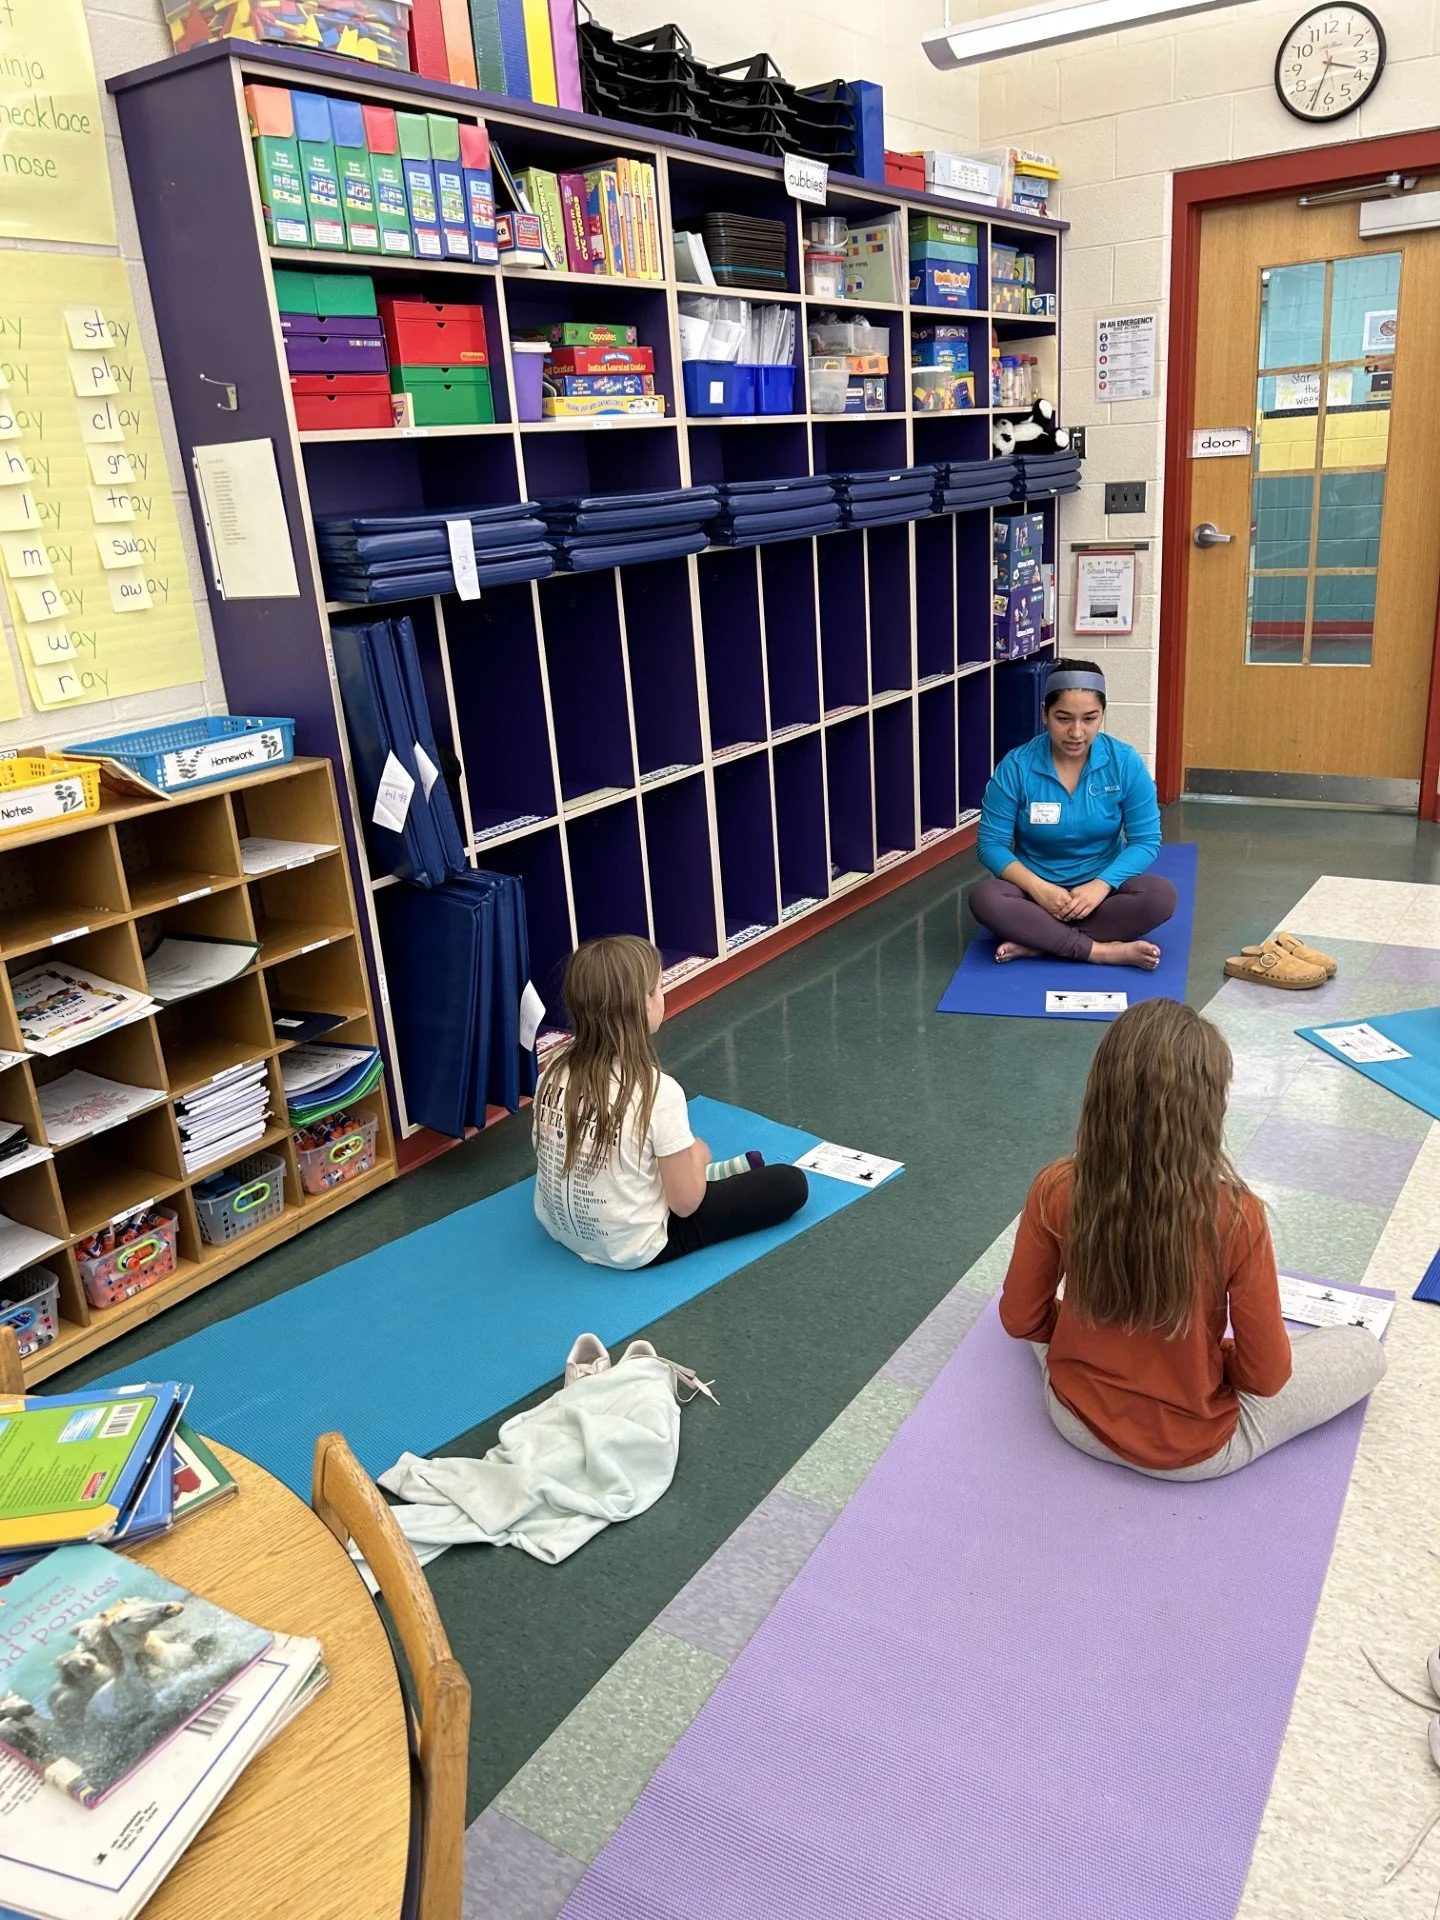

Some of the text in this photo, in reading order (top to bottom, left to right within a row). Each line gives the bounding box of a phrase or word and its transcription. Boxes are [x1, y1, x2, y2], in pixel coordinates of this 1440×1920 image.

[1324, 20, 1339, 34] 12
[1347, 22, 1351, 34] 1
[1310, 29, 1320, 42] 11
[1353, 34, 1364, 47] 2
[1297, 44, 1313, 58] 10
[1358, 51, 1368, 63] 3
[1292, 64, 1302, 76] 9
[1353, 69, 1363, 81] 4
[1296, 80, 1306, 91] 8
[1340, 84, 1350, 96] 5
[1308, 90, 1317, 102] 7
[1324, 92, 1334, 104] 6
[0, 94, 91, 134] necklace
[3, 153, 58, 179] nose
[789, 172, 823, 193] cubbies
[573, 196, 589, 261] CVC WORDS
[1117, 316, 1153, 327] EMERGENCY
[83, 310, 130, 347] stay
[589, 332, 617, 344] Opposites
[91, 356, 134, 392] play
[587, 363, 646, 372] Instant Learning Center
[1291, 373, 1311, 384] Star
[1304, 385, 1319, 394] the
[92, 402, 141, 435] clay
[1201, 436, 1241, 449] door
[5, 451, 148, 487] hay gray
[22, 488, 152, 530] lay tray
[22, 537, 158, 575] may sway
[1105, 568, 1124, 577] Pledge
[41, 577, 169, 615] pay away
[47, 630, 97, 659] way
[58, 670, 110, 695] ray
[211, 748, 255, 767] Homework
[1, 805, 34, 819] Notes
[573, 1188, 594, 1197] JASMINE
[573, 1194, 607, 1205] POCAHONTAS
[31, 1577, 118, 1646] ponies
